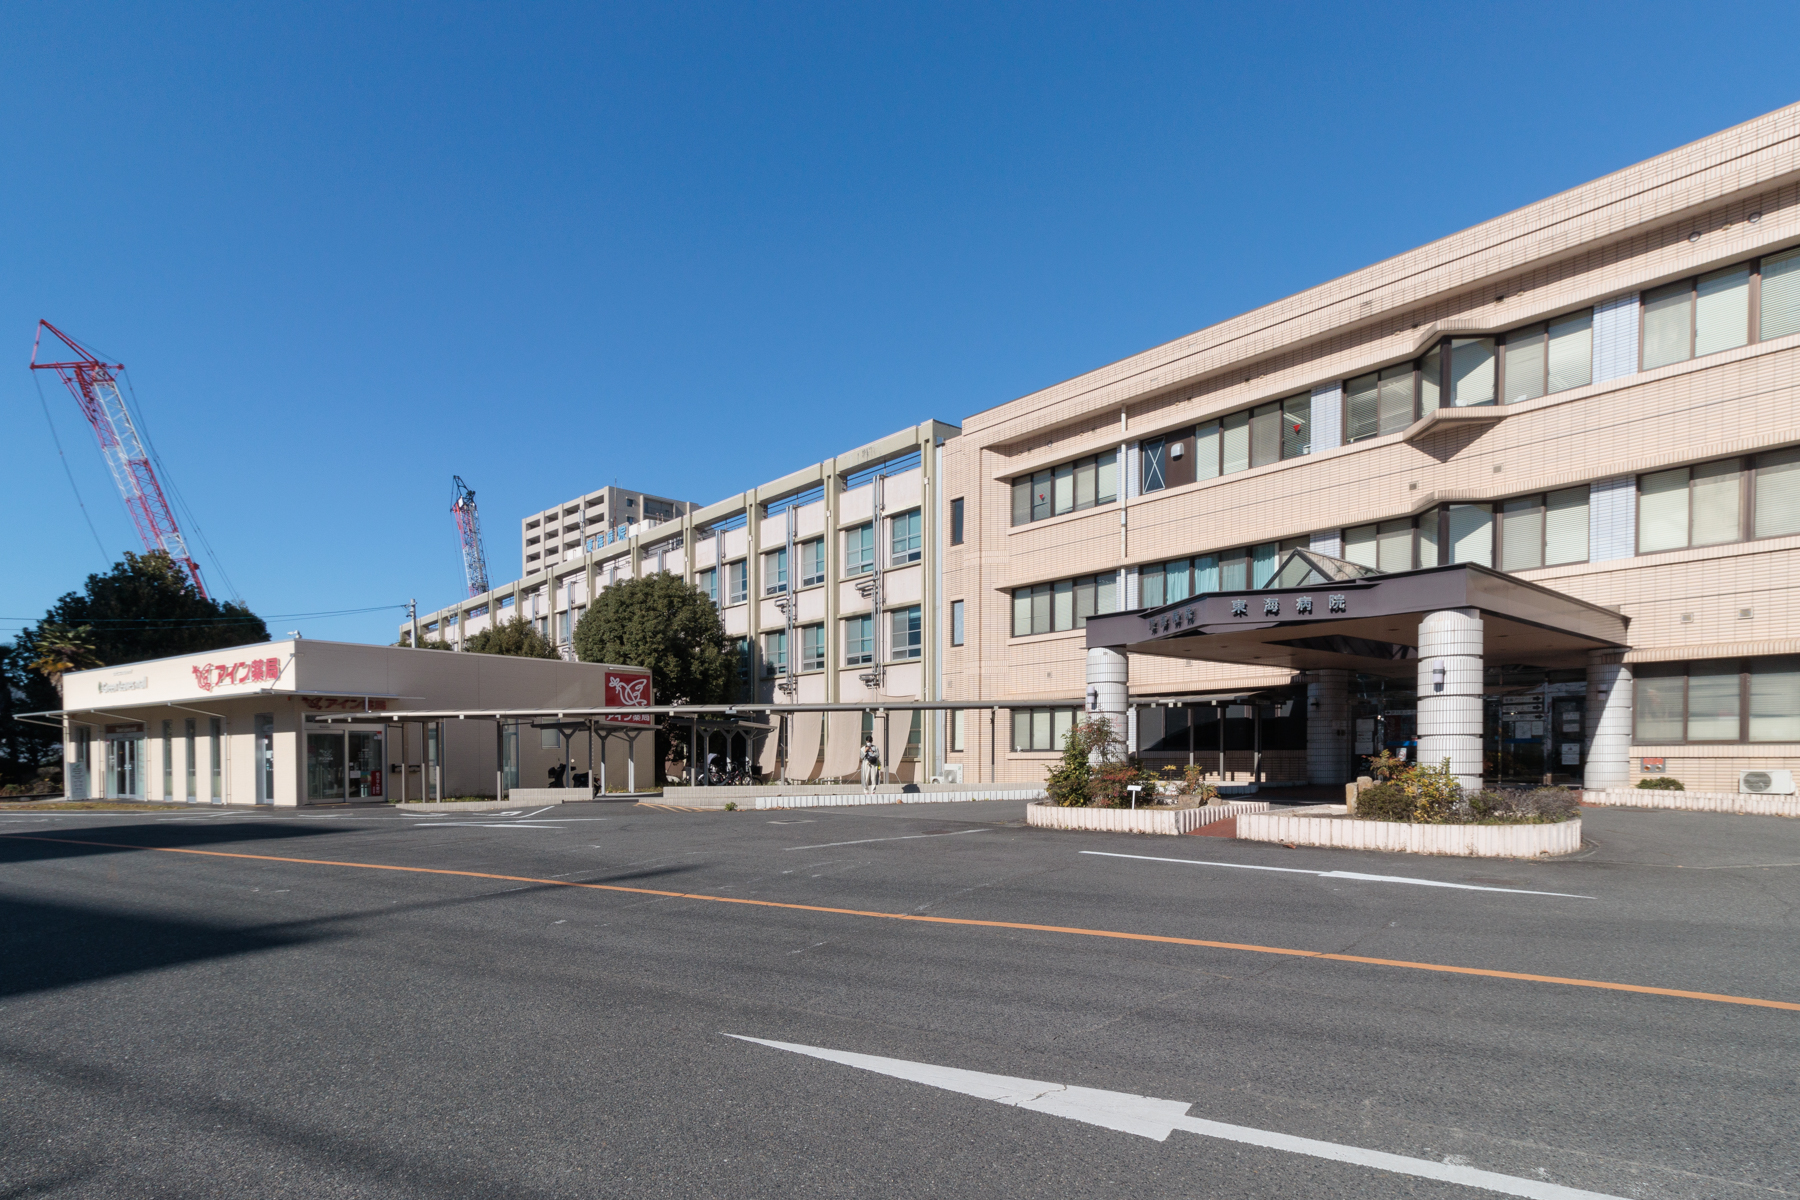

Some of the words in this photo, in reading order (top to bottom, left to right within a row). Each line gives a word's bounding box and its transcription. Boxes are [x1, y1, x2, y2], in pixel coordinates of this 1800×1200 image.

[1231, 594, 1346, 614] 東海病院
[214, 657, 280, 686] アイン薬局
